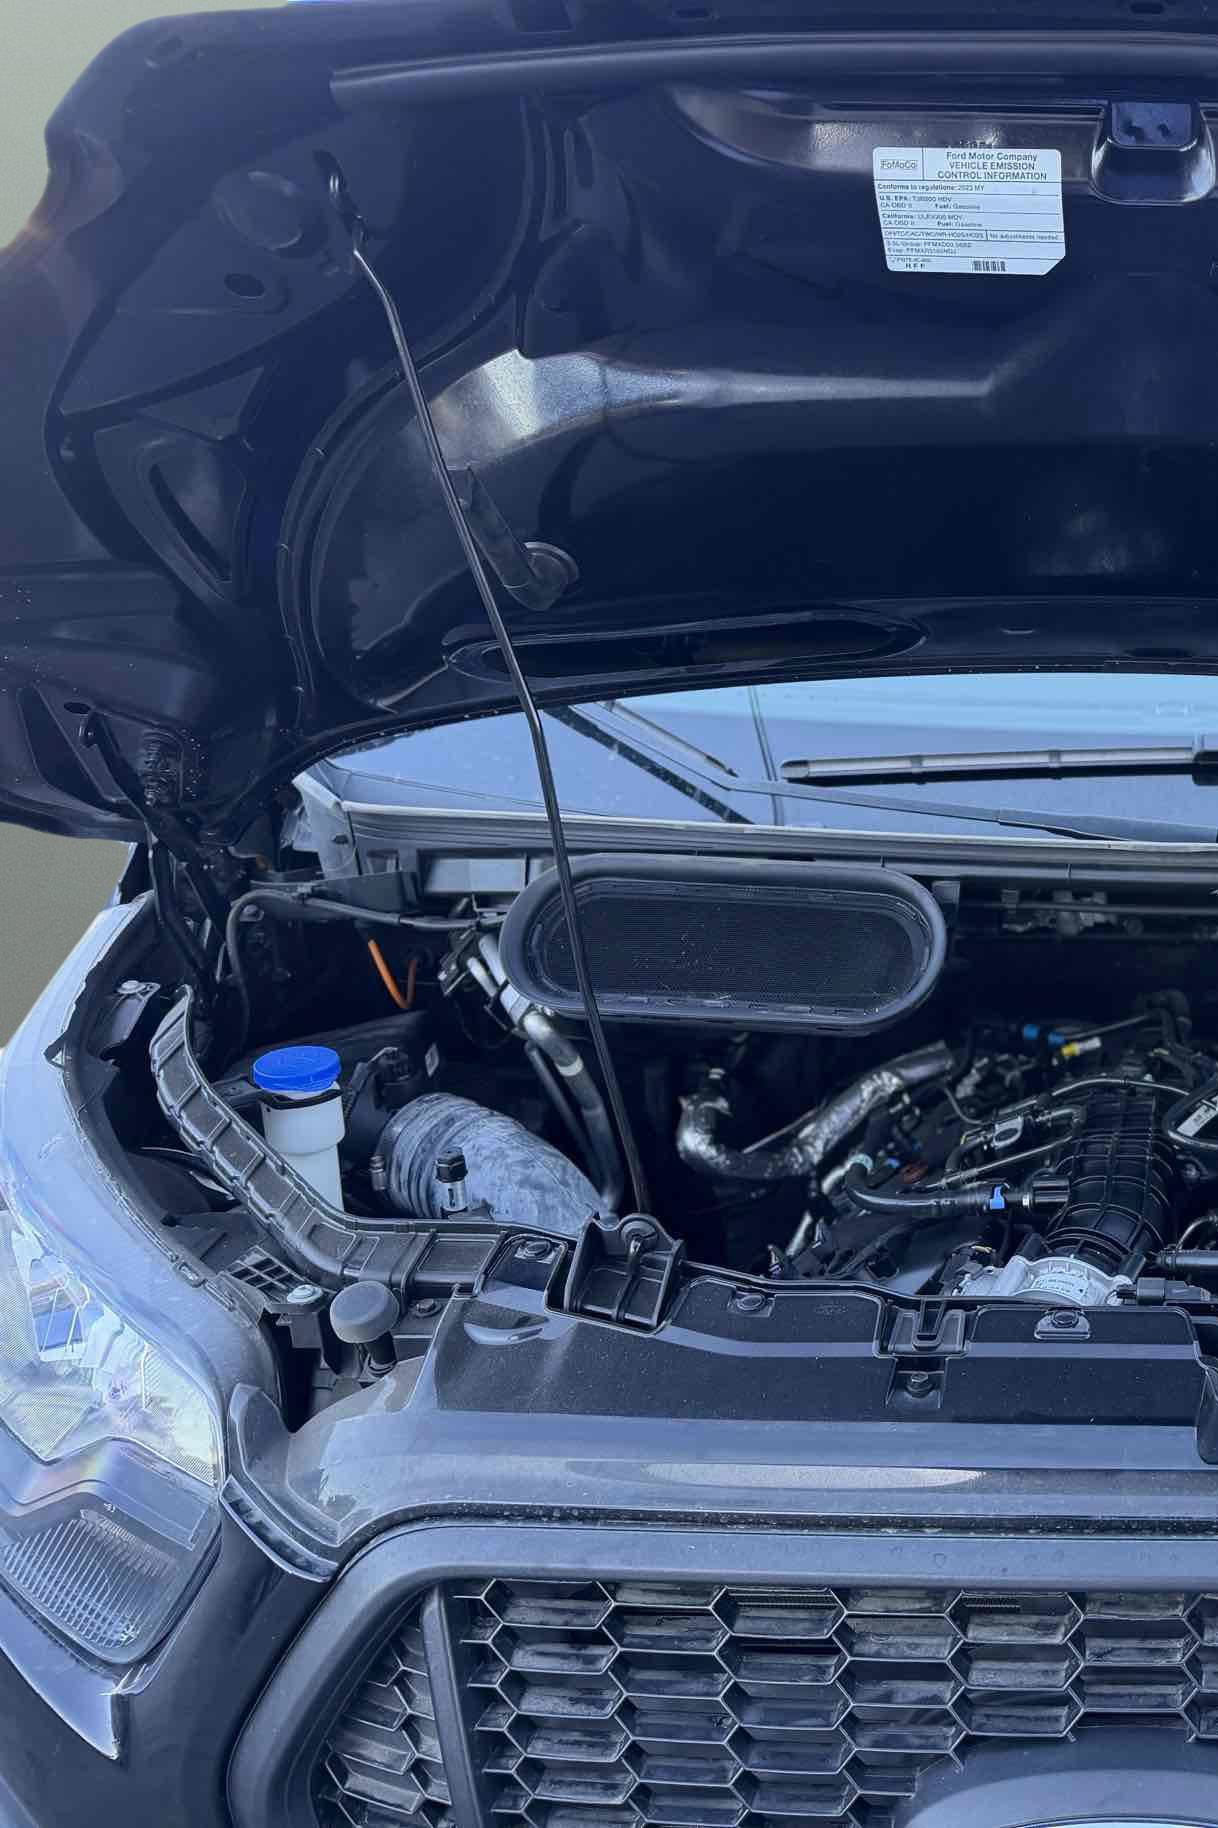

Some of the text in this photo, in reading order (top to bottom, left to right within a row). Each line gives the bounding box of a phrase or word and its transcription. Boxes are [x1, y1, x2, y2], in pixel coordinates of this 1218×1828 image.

[946, 152, 1037, 162] Ford Motor Company
[949, 162, 1035, 170] VEHICLE EMISSION
[938, 172, 1047, 180] CONTROL INFORMATION
